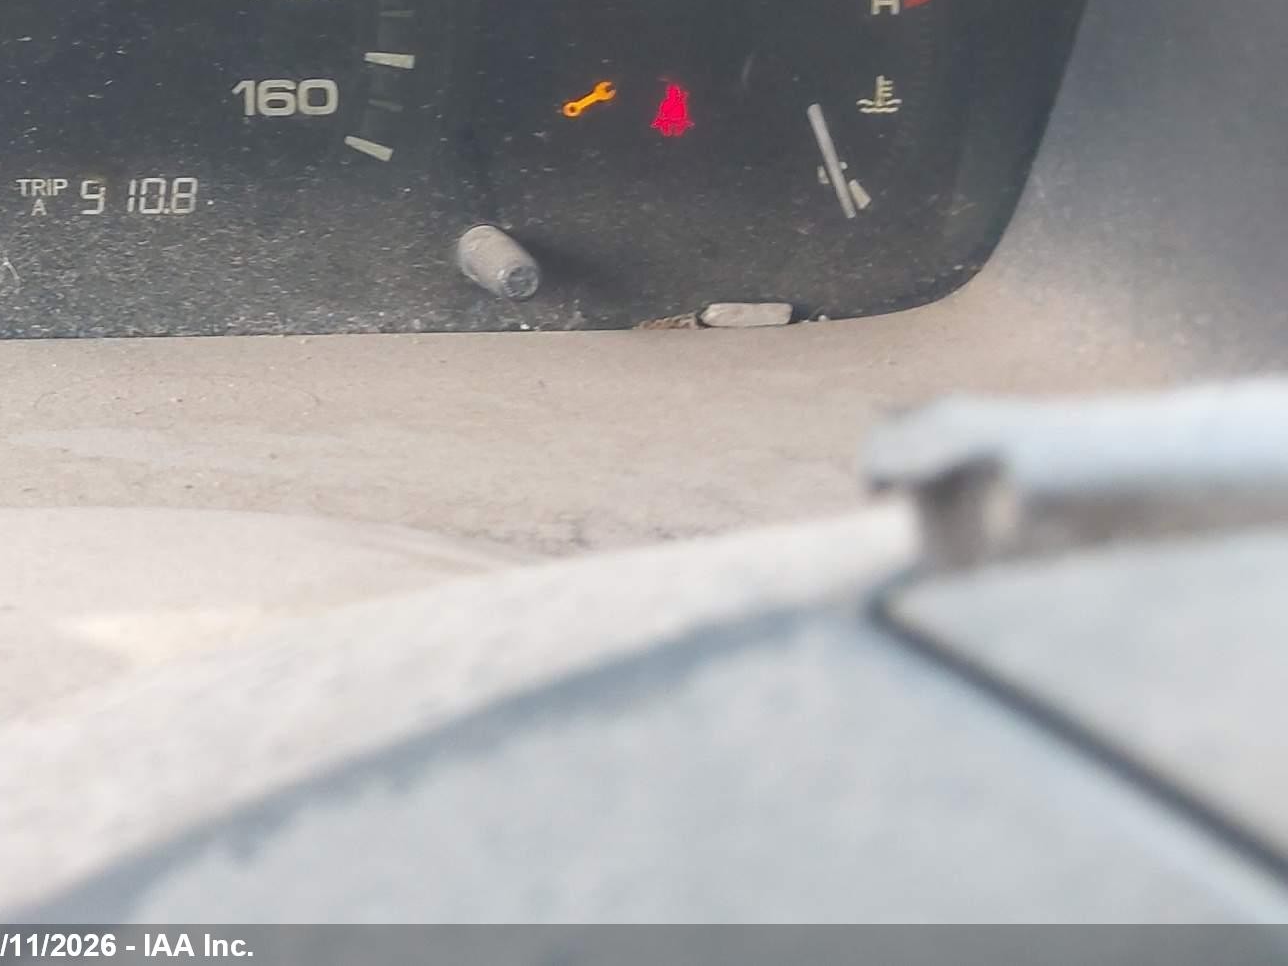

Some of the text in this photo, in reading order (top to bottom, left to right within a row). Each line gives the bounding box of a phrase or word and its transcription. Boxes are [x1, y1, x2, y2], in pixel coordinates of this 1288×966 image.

[233, 77, 339, 115] 160
[16, 178, 68, 197] TRIP
[31, 198, 47, 216] A
